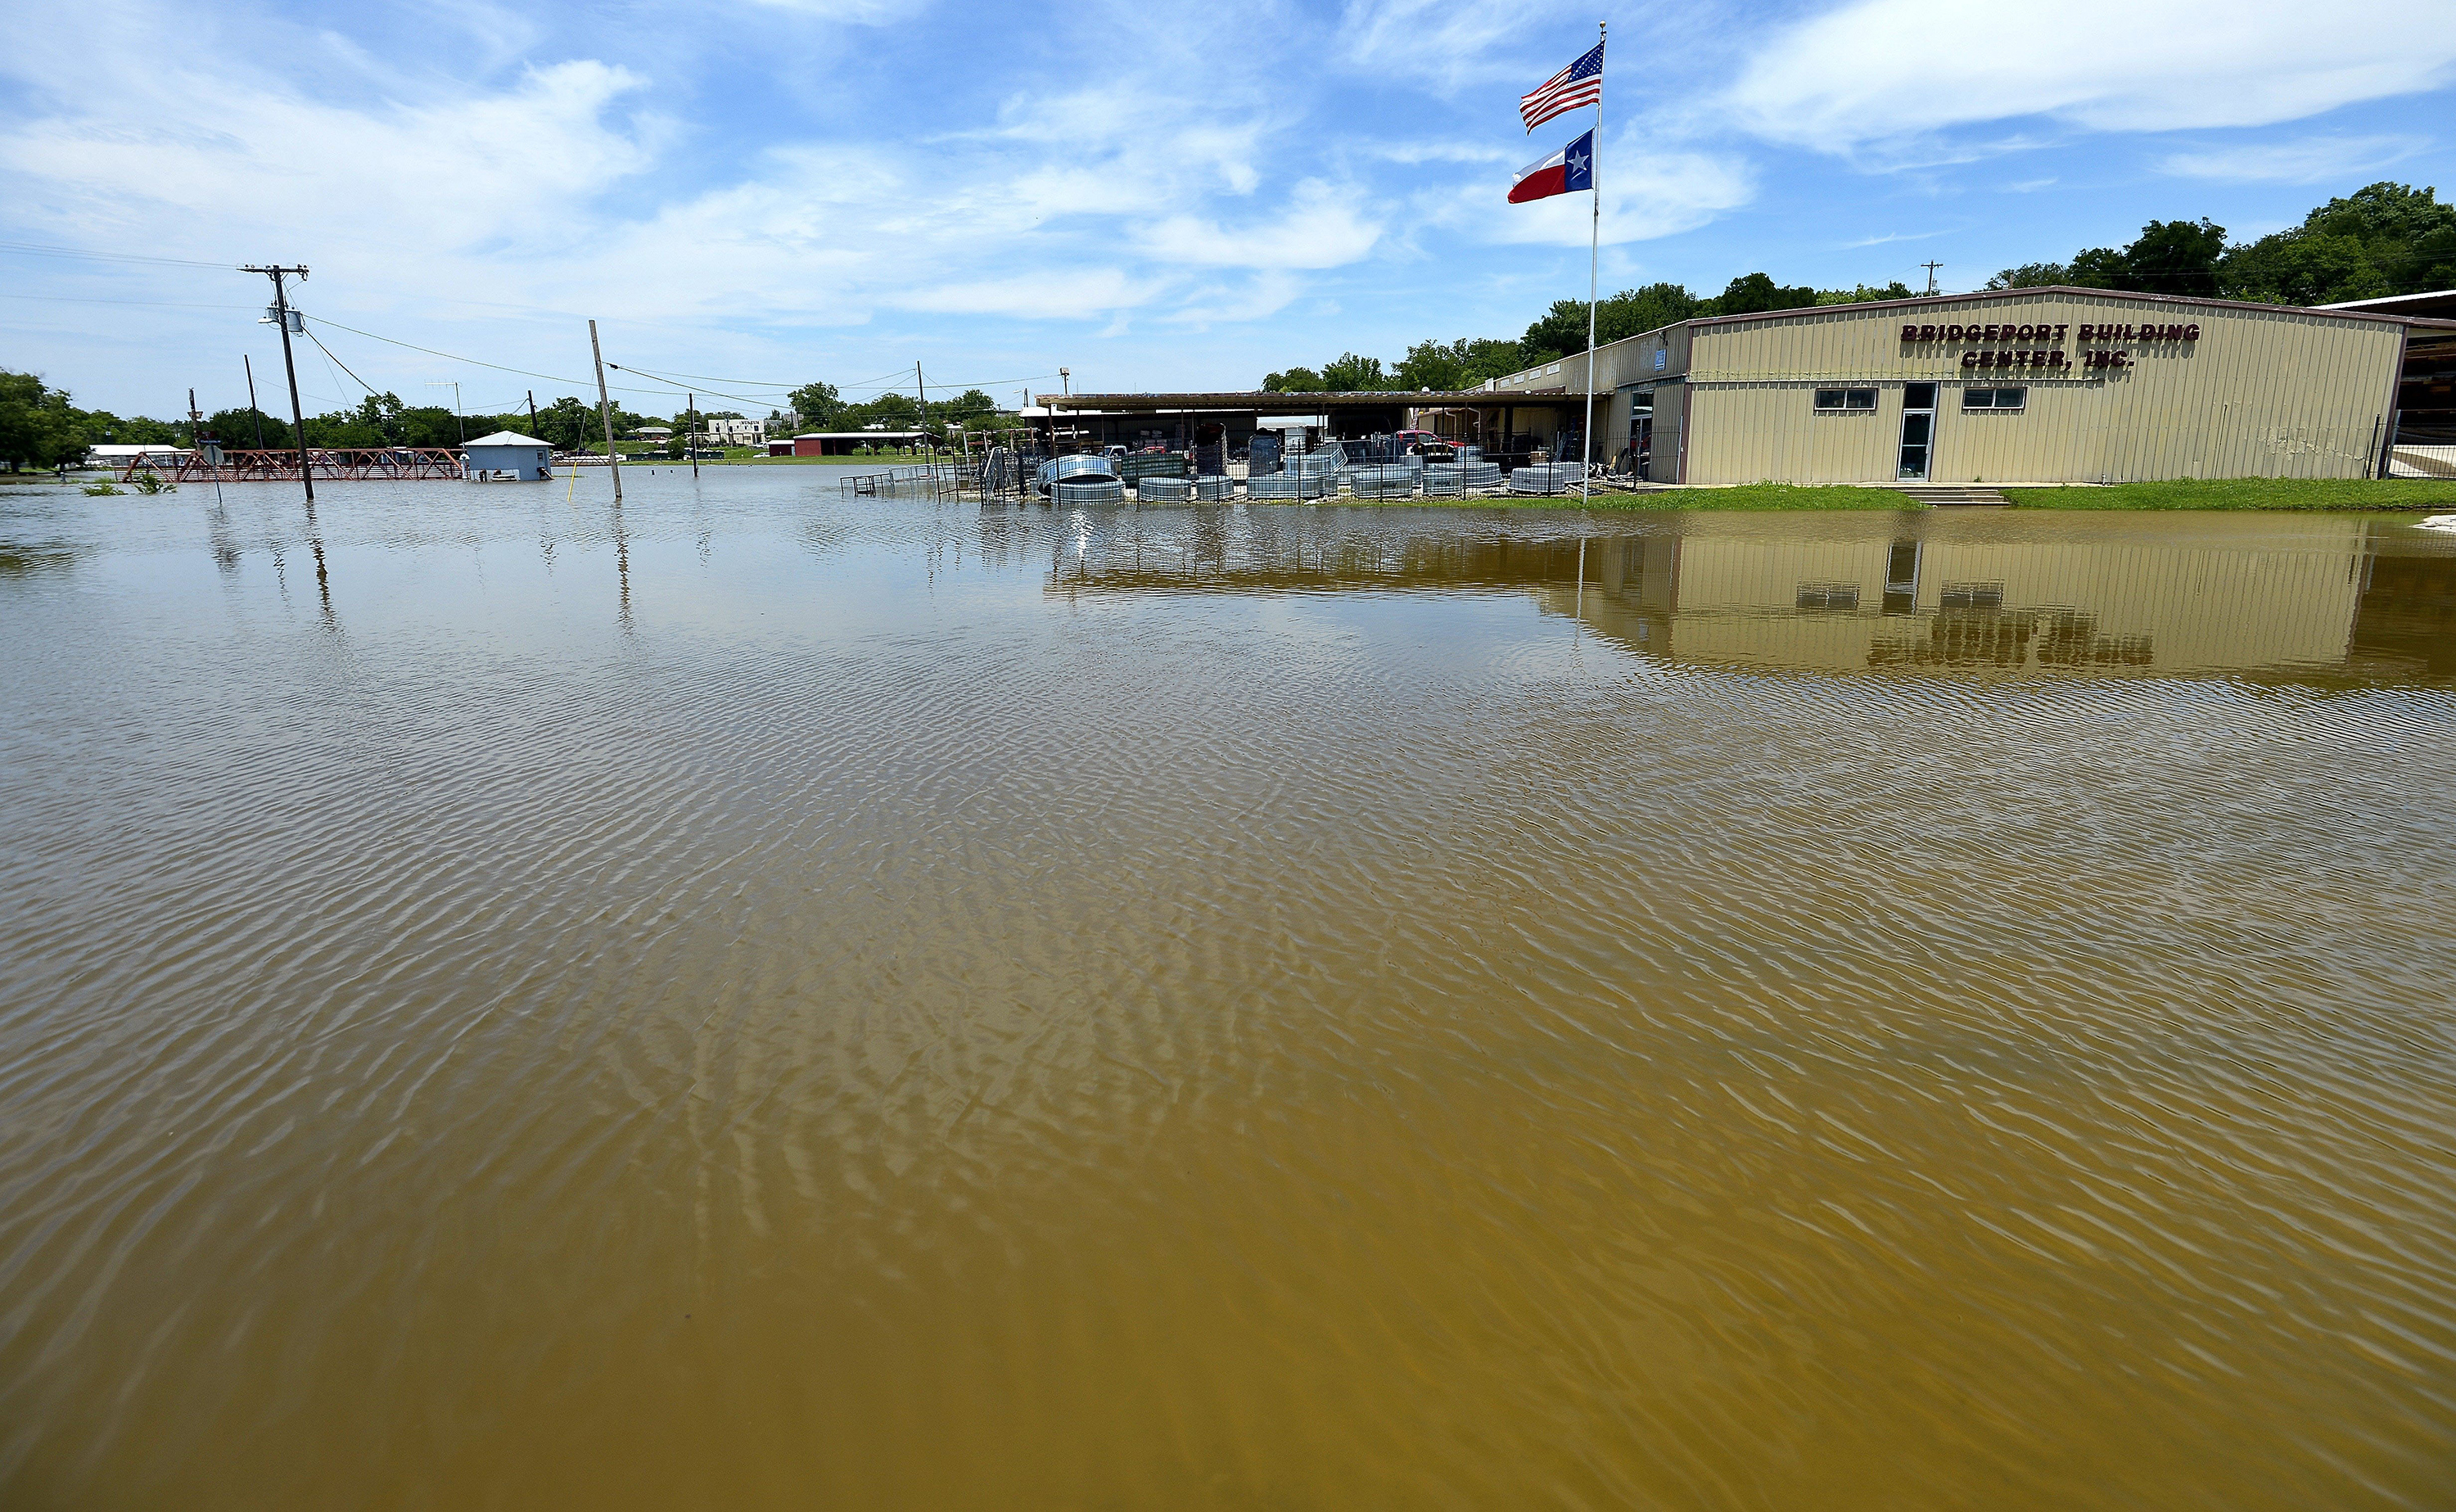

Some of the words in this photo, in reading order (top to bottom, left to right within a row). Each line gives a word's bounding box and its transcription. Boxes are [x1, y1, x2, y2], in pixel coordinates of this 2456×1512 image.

[1901, 323, 2070, 341] BRIDGEPORT
[2078, 323, 2201, 341] BUILDING
[1961, 350, 2073, 371] CENTER,
[2085, 350, 2135, 368] INC.
